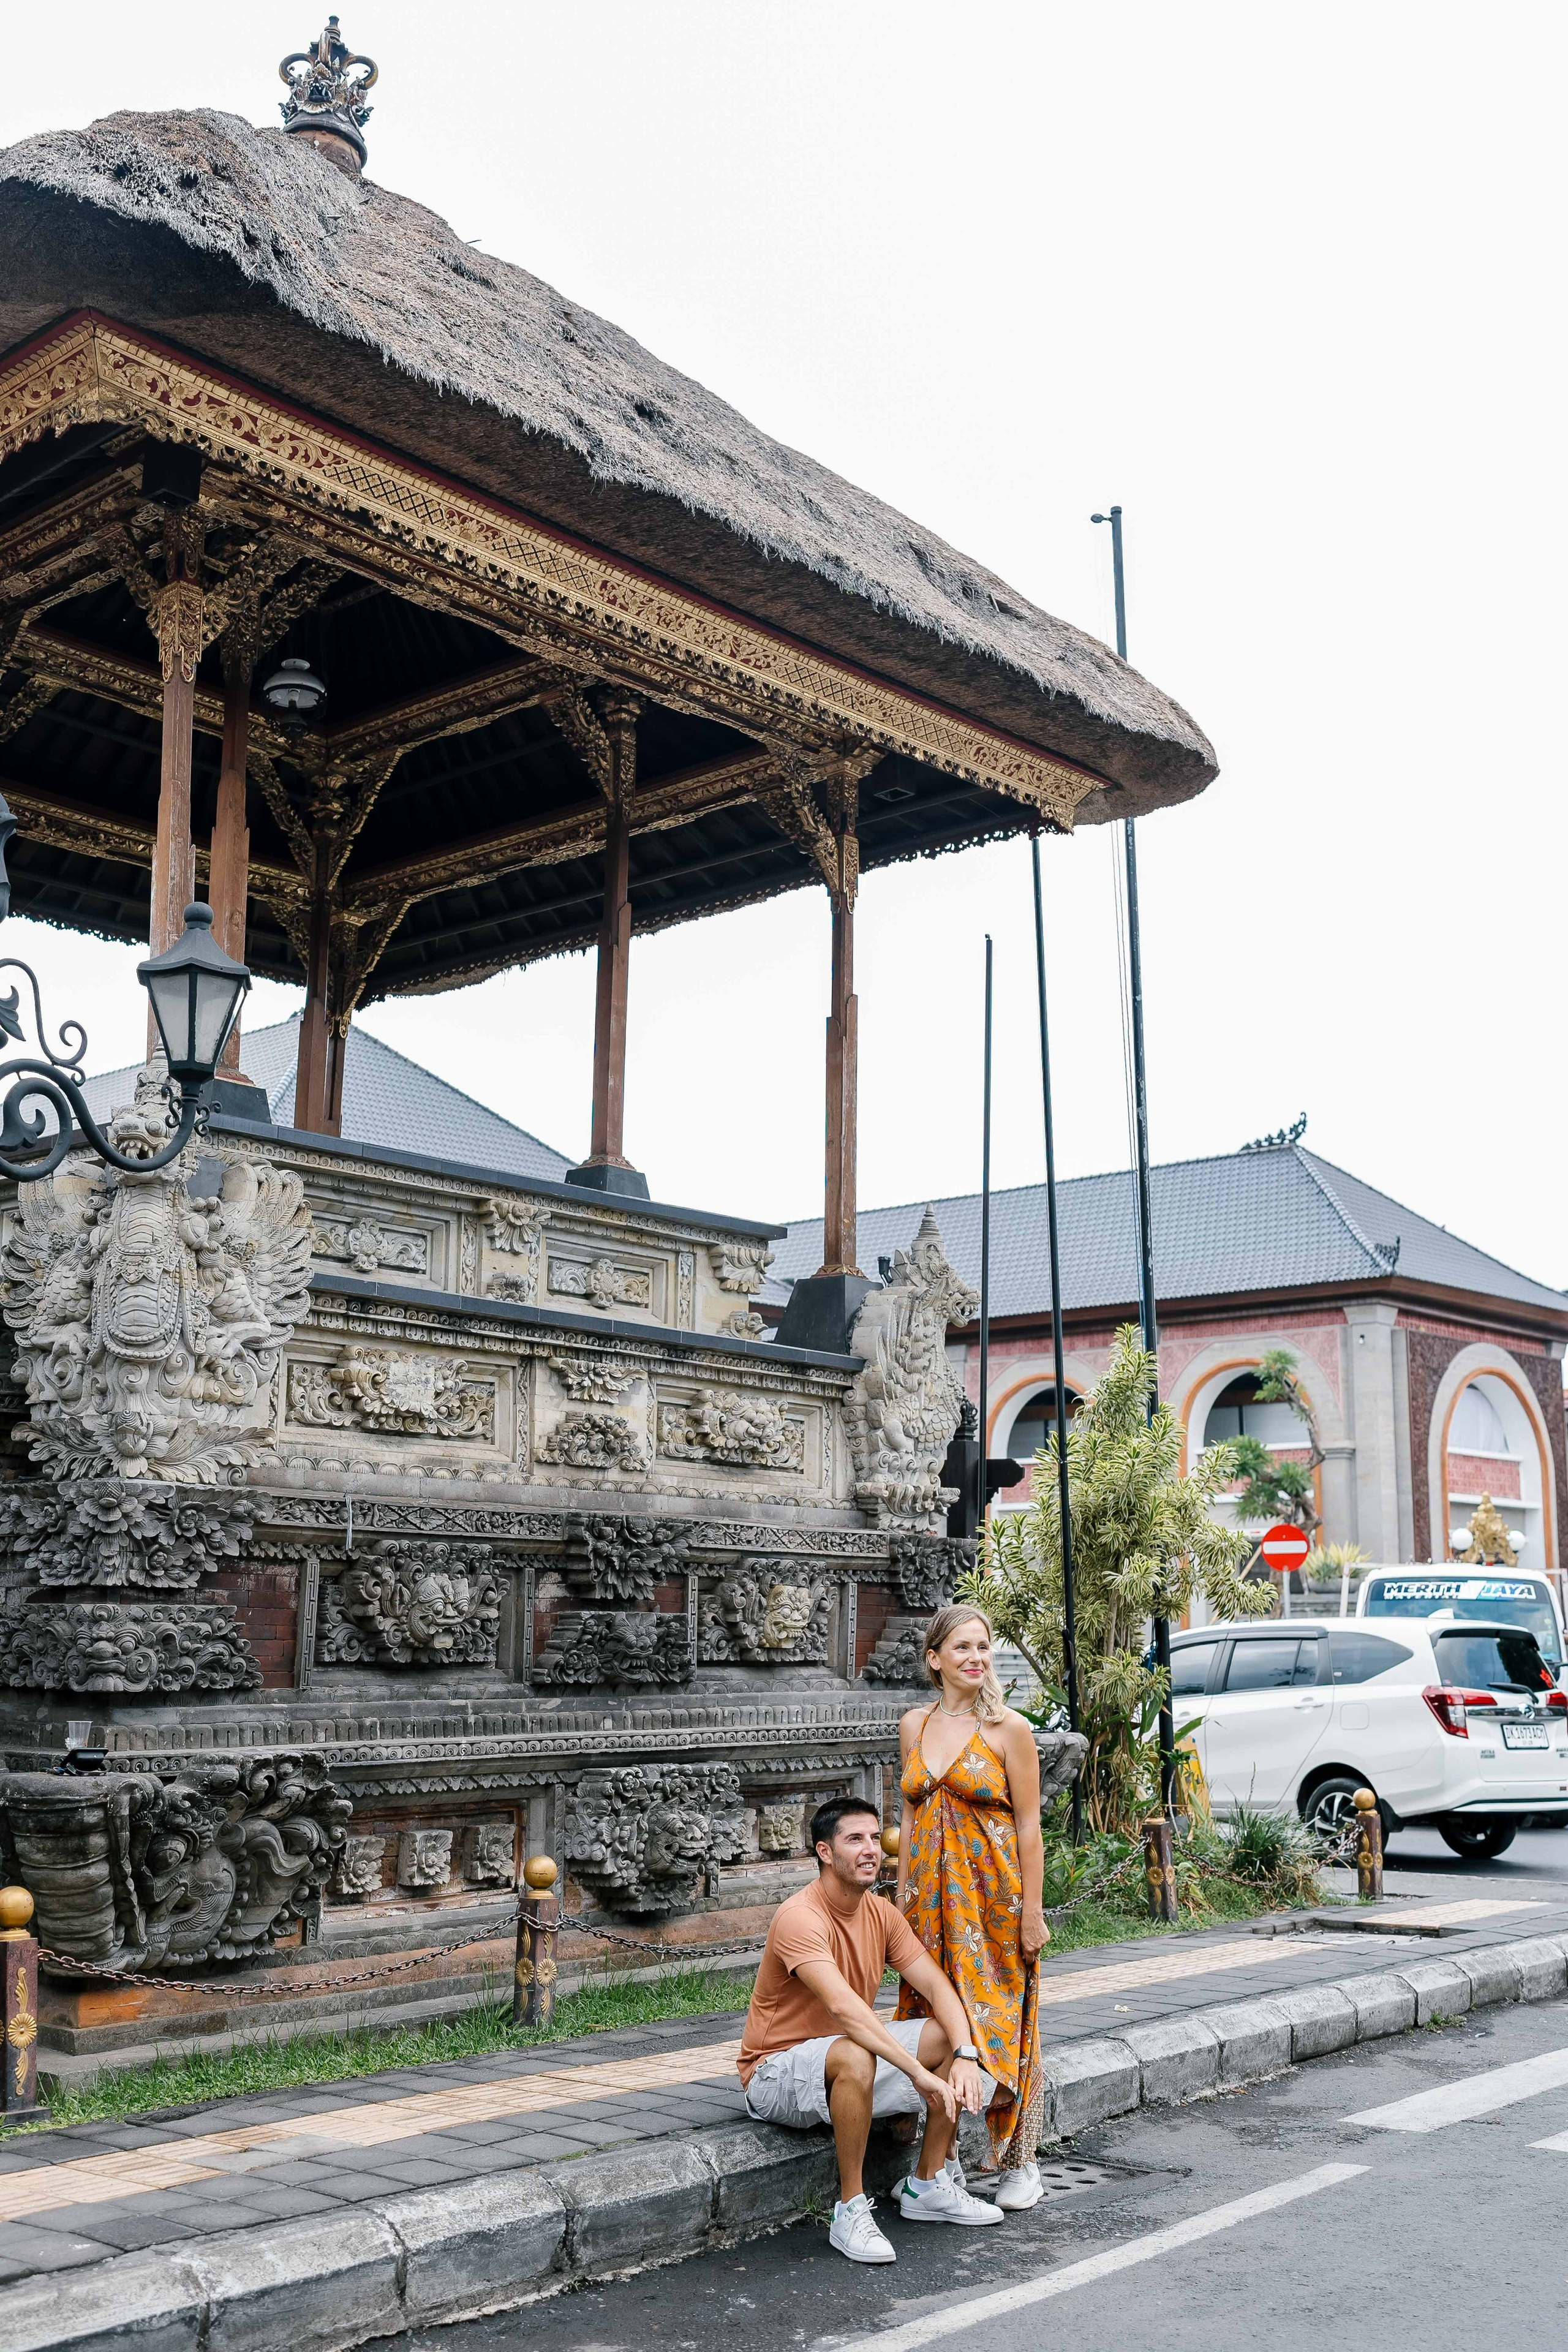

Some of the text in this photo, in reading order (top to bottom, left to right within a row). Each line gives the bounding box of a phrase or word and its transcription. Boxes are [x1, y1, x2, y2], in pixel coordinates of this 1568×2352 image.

[1384, 1582, 1536, 1597] MERTH JAYA
[1506, 1727, 1517, 1739] DK
